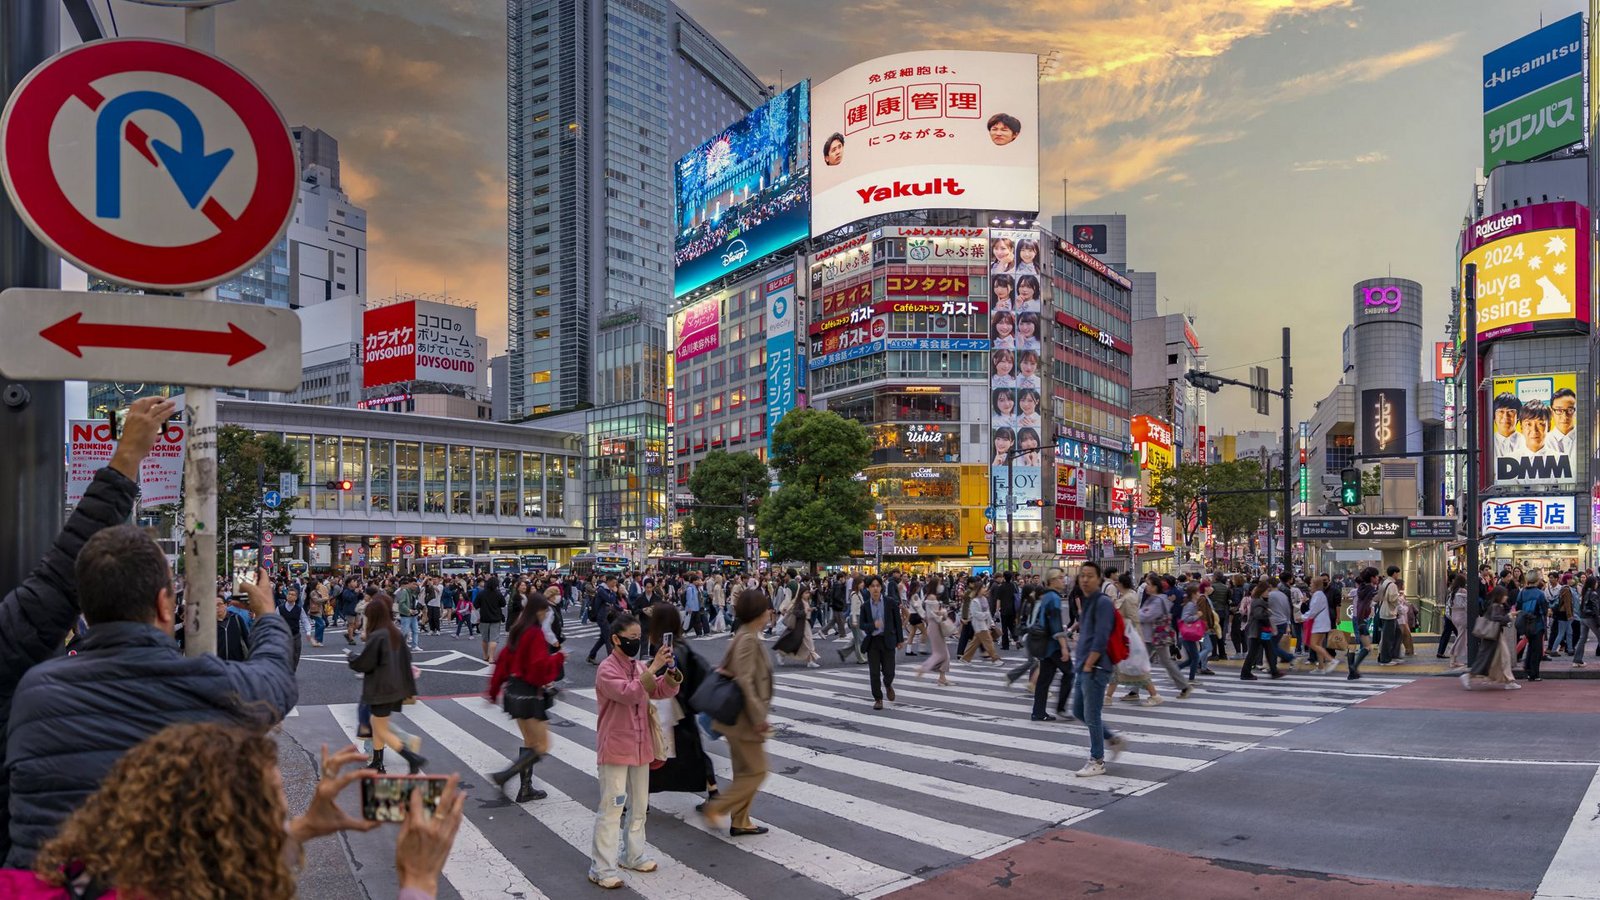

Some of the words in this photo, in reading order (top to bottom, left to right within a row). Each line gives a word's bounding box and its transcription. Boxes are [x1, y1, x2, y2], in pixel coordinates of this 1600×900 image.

[1484, 41, 1580, 89] Hisamitsu
[868, 66, 957, 84] 免疫細胞は、
[847, 92, 977, 126] 健康管理
[1489, 97, 1575, 153] サロンパス
[868, 128, 955, 147] につながる。
[856, 178, 965, 204] Yakult
[898, 227, 983, 237] しゃぶしゃぶバイキング
[1475, 213, 1522, 239] Rakuten
[934, 243, 985, 259] しゃぶ葉
[1484, 241, 1525, 270] 2024
[839, 251, 870, 273] しゃぶ葉
[812, 271, 822, 282] 9F
[887, 277, 966, 291] コンタクト
[824, 284, 872, 312] プライス
[1362, 286, 1402, 313] 109
[850, 306, 875, 324] ガスト
[942, 301, 979, 315] ガスト
[417, 313, 462, 332] ココロの
[366, 326, 414, 351] カラオケ
[417, 328, 474, 349] ボリューム、
[812, 341, 823, 353] 7F
[838, 327, 869, 349] ガスト
[919, 339, 988, 350] 英会話イーオン
[1098, 331, 1115, 347] ガスト
[365, 343, 414, 363] JOYSOUND
[417, 342, 475, 360] あげていこう。
[416, 355, 475, 373] JOYSOUND
[368, 398, 384, 406] カラオケ
[72, 424, 112, 443] NO
[906, 431, 942, 443] Ushi8
[72, 443, 113, 451] DRINKING
[151, 444, 182, 452] OKING
[1498, 454, 1573, 480] DMM
[1108, 515, 1128, 529] LUSH
[1138, 509, 1156, 518] NO
[1370, 522, 1400, 531] しぶちか
